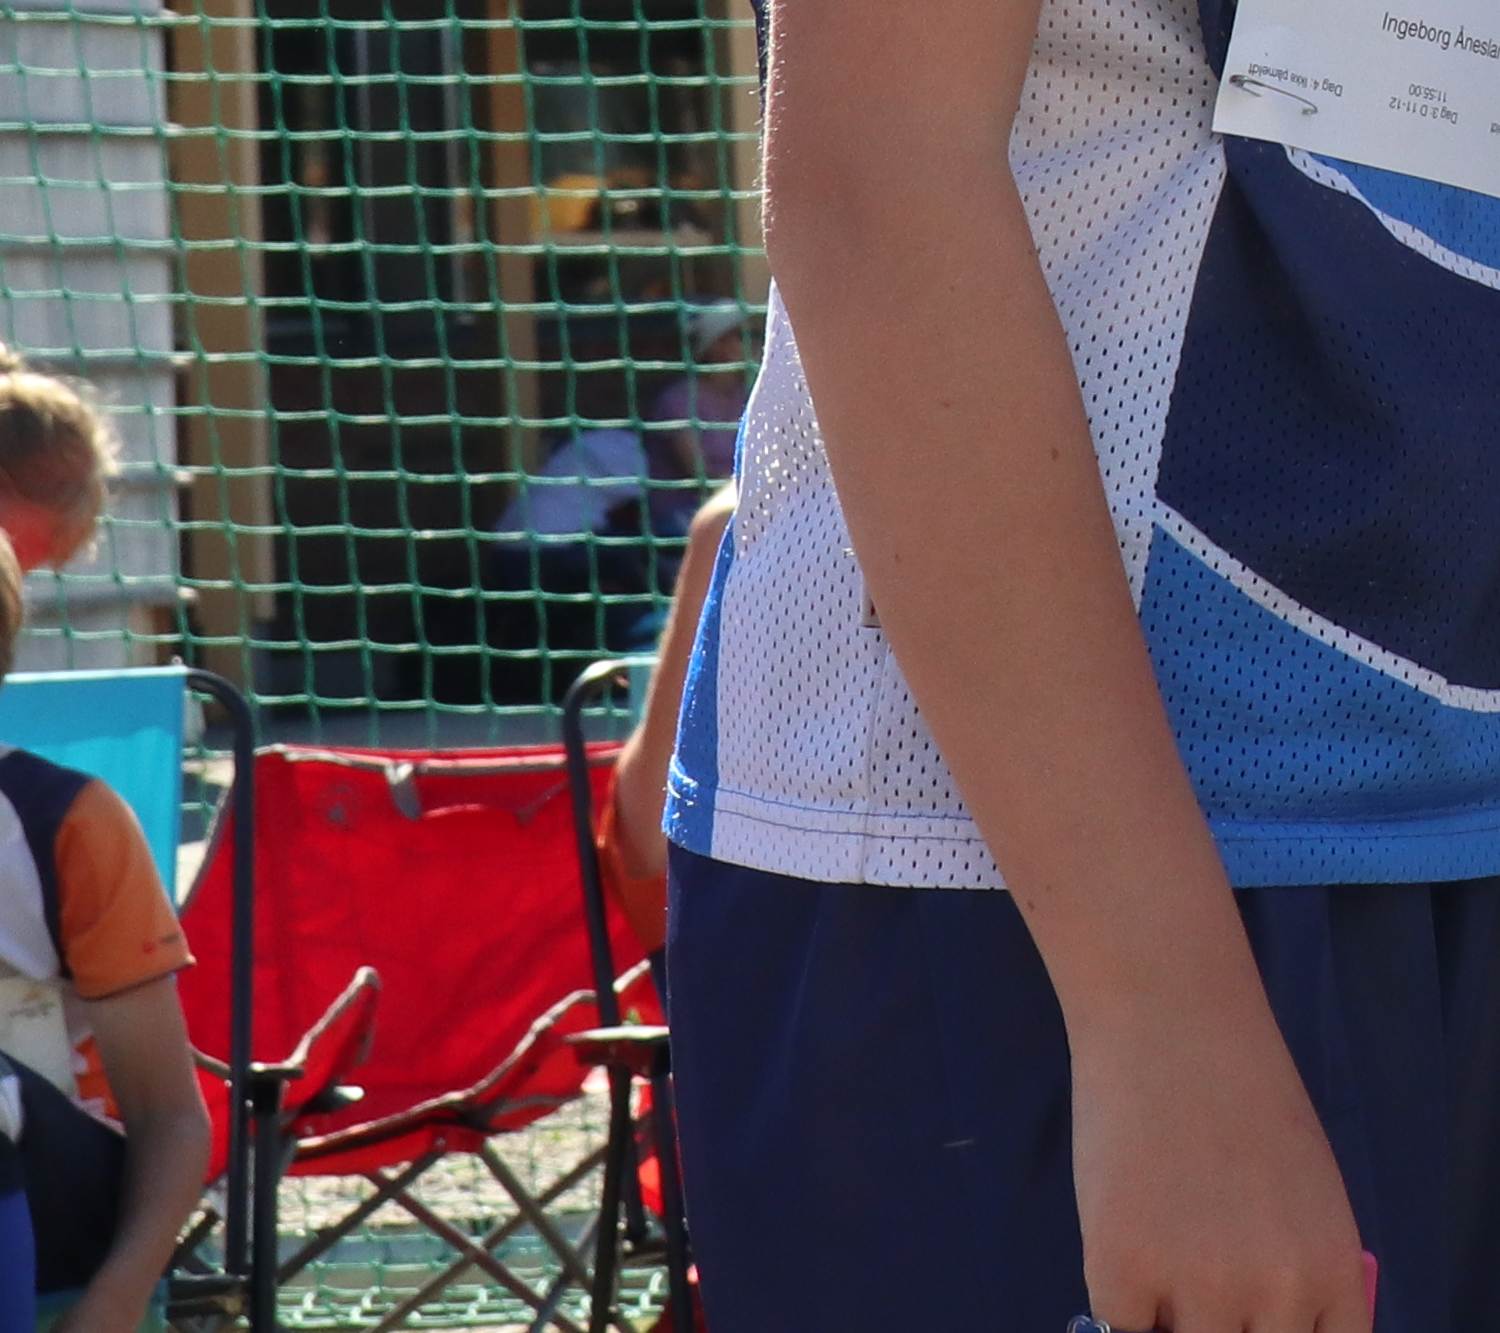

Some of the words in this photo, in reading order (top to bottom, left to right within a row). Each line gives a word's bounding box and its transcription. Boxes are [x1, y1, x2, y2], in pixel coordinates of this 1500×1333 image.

[1381, 11, 1451, 51] Ingeborg
[1248, 62, 1290, 81] påmeldt
[1310, 80, 1320, 91] 4:
[1321, 82, 1344, 97] Dag
[1408, 83, 1448, 103] 11:55:00
[1388, 96, 1418, 114] 11-12
[1420, 104, 1428, 117] D
[1440, 108, 1458, 125] Dag
